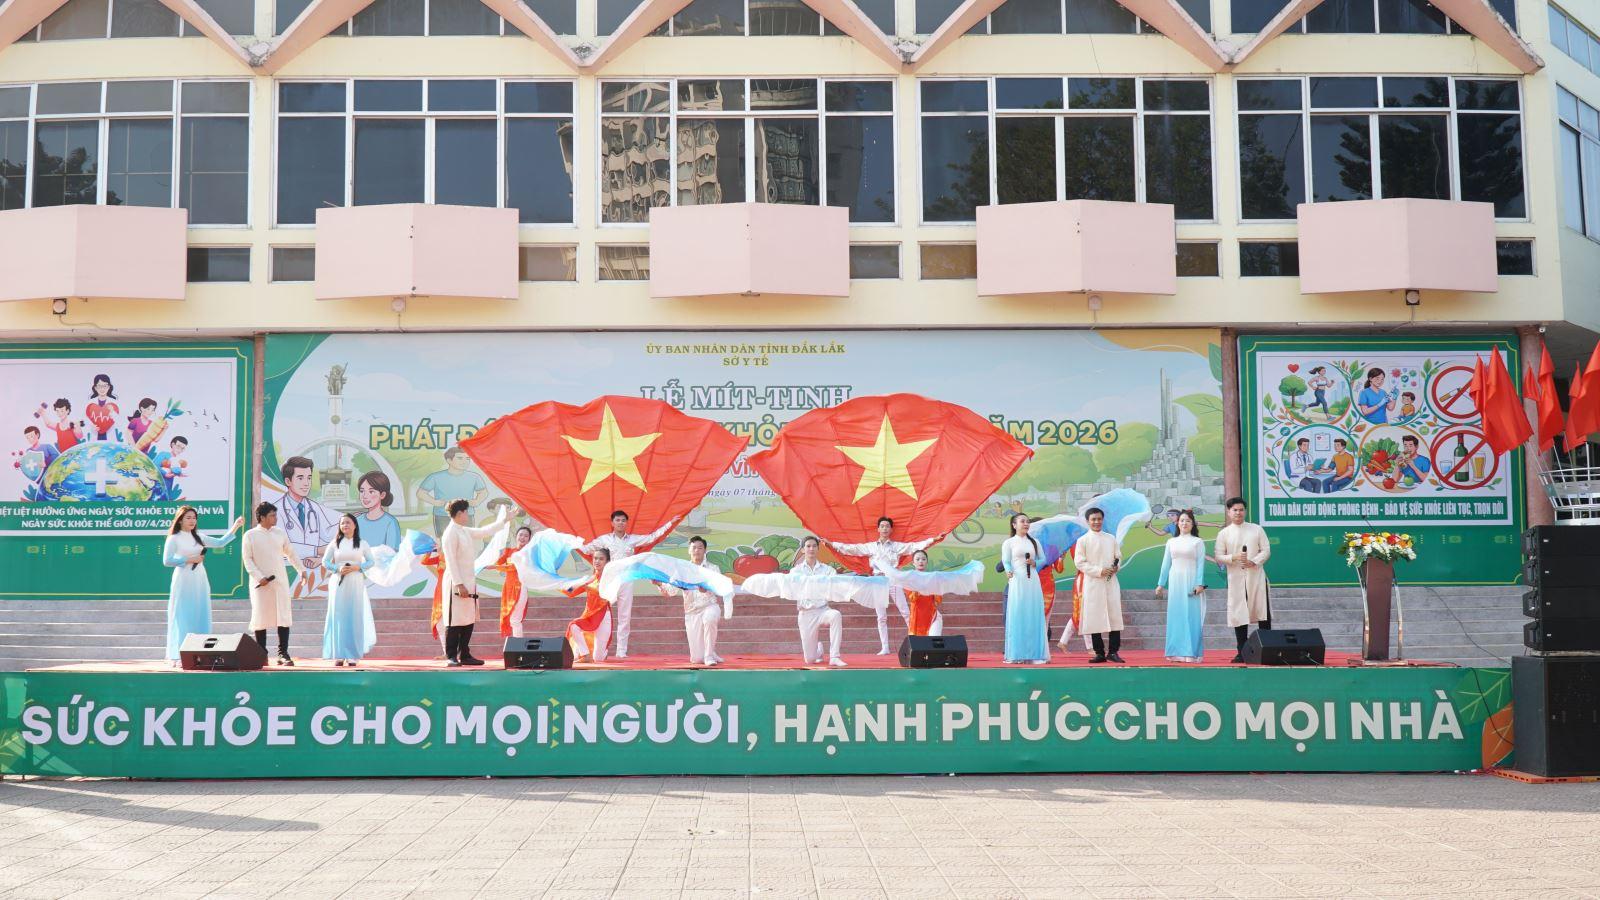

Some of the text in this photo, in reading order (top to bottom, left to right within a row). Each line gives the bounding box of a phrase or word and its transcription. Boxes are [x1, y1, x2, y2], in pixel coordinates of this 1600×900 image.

[665, 345, 690, 353] BAN
[693, 344, 727, 353] NHÂN
[731, 344, 755, 353] DÂN
[759, 343, 788, 353] TỈNH
[723, 354, 768, 366] SỞ Y TẾ
[690, 381, 852, 410] MÍT-TINH
[369, 418, 453, 449] PHÁT
[1037, 419, 1118, 445] 2026
[708, 488, 731, 497] ngày
[747, 488, 776, 497] tháng
[13, 506, 31, 517] LIỆT
[67, 505, 87, 516] ỨNG
[89, 505, 114, 516] NGÀY
[115, 505, 134, 516] SỨC
[136, 505, 162, 515] KHỎE
[164, 505, 180, 515] TO
[213, 505, 225, 515] VÀ
[1269, 502, 1286, 516] TOÀN
[1287, 502, 1301, 516] DÂN
[1302, 501, 1317, 516] CHỦ
[1318, 501, 1336, 518] ĐỘNG
[1338, 501, 1360, 516] PHÒNG
[1361, 501, 1379, 517] BỆNH
[1384, 500, 1398, 516] BẢO
[1399, 501, 1408, 517] VỆ
[1409, 501, 1423, 515] SỨC
[1424, 500, 1441, 515] KHỎE
[21, 517, 172, 528] NGÀY SỨC KHỎE THẾ GIỚI 07/4/20
[22, 690, 1464, 757] SỨC KHỎE CHO MỌI NGƯỜI, HẠNH PHÚC CHO MỌI NHÀ
